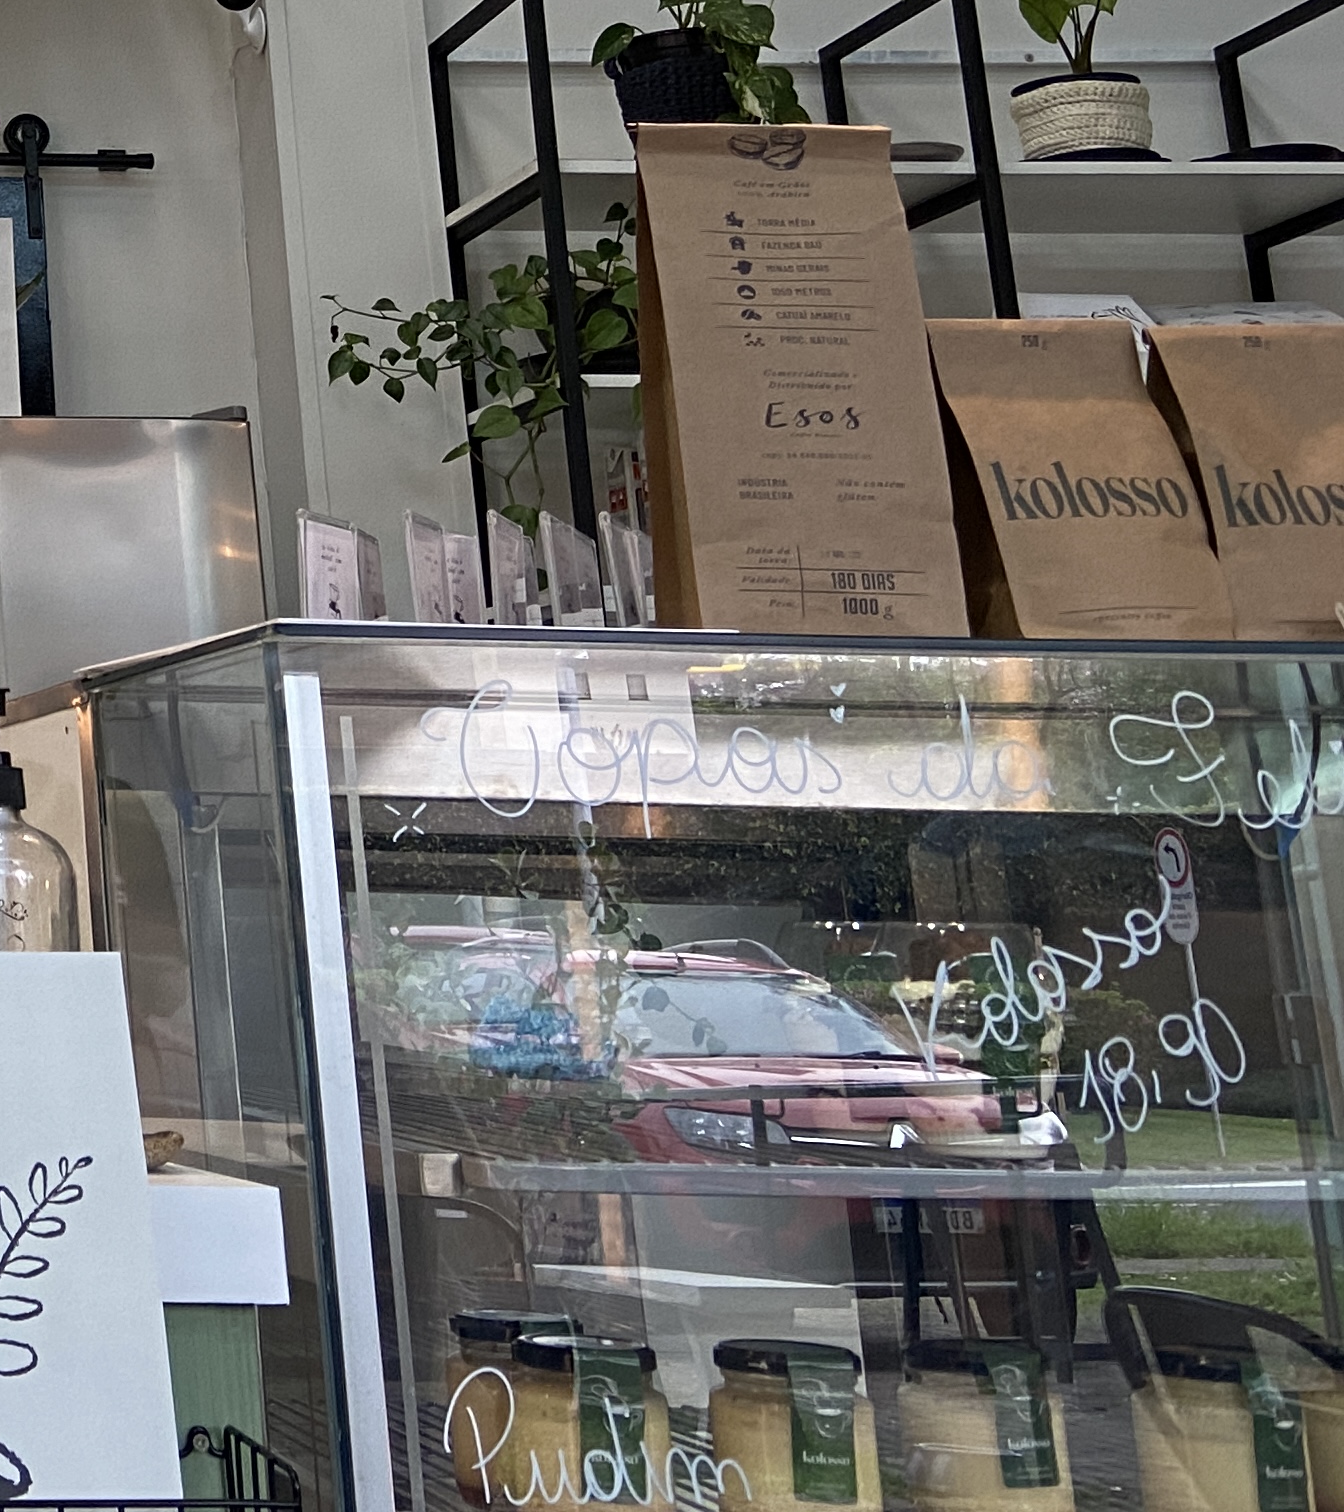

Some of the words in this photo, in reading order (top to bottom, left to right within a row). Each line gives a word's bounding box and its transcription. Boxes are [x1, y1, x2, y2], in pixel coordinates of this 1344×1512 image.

[989, 461, 1189, 521] kolosso
[831, 572, 856, 590] 180
[862, 573, 896, 591] DIAS
[842, 597, 879, 615] 1000
[1109, 690, 1344, 828] Fel
